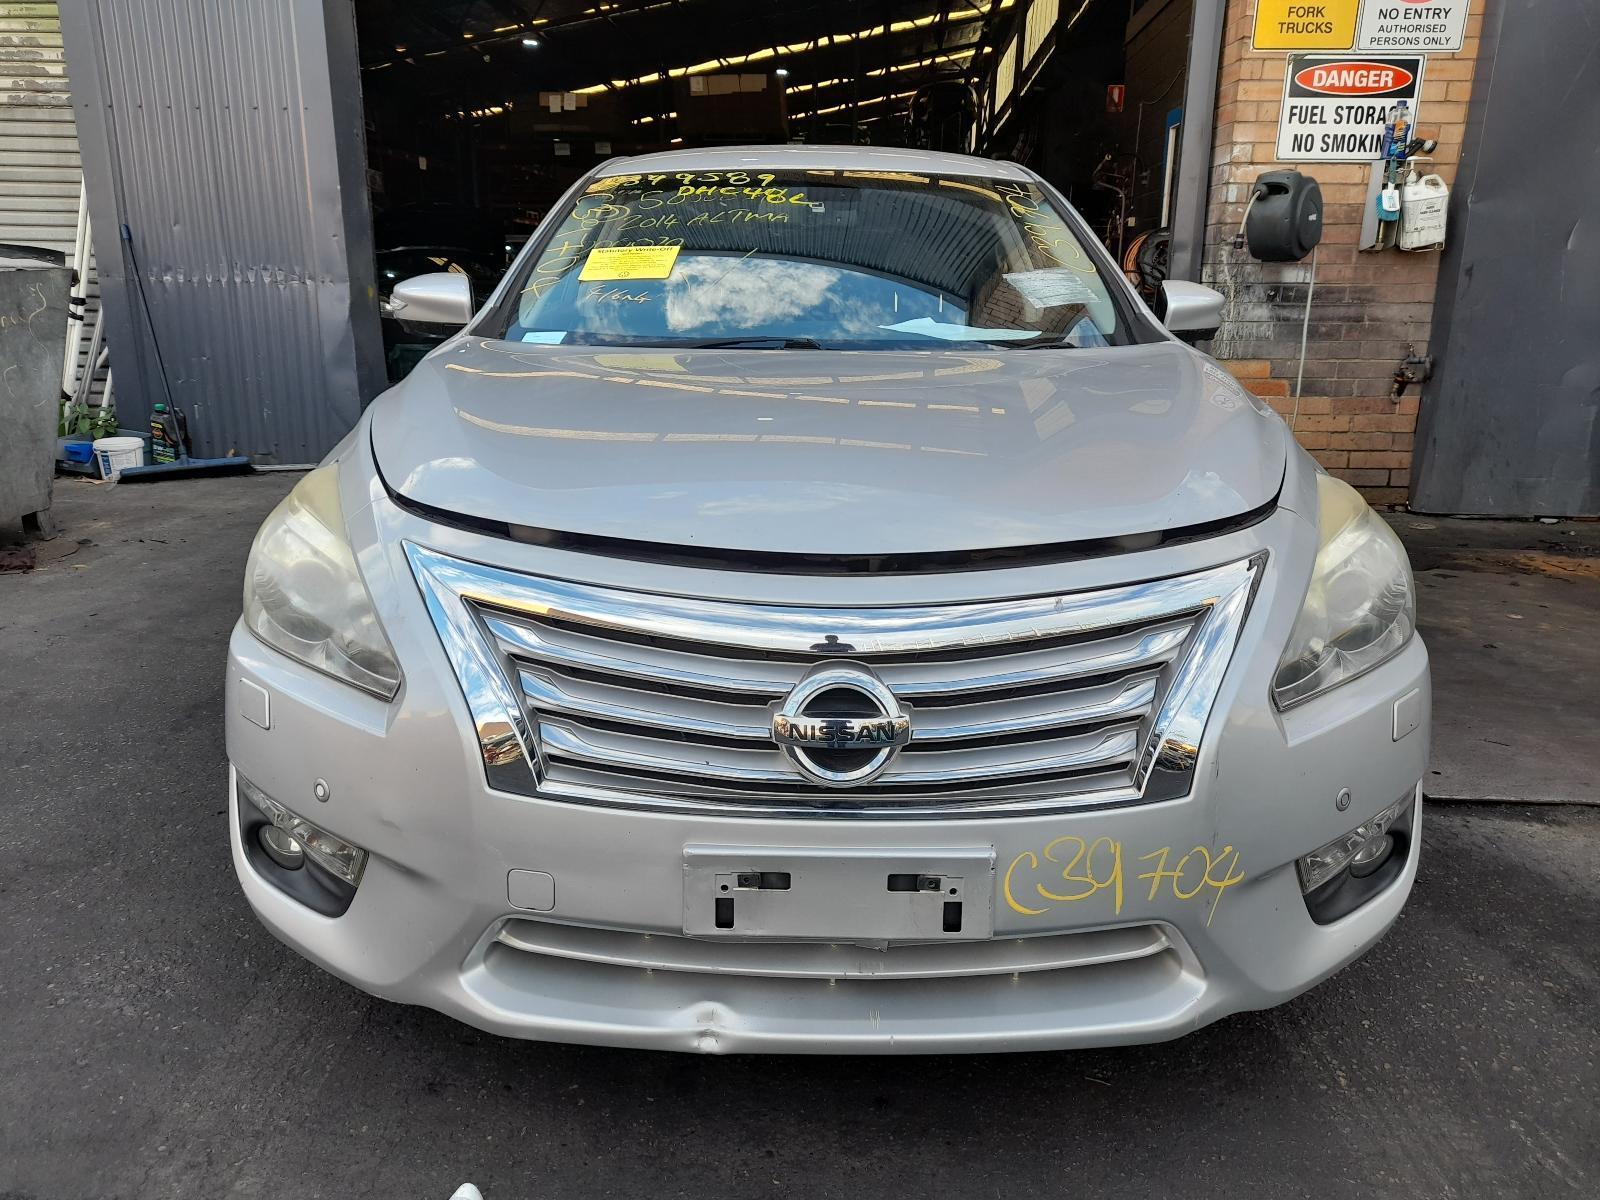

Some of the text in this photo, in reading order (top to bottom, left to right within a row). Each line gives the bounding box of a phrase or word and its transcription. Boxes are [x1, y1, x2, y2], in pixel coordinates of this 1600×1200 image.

[1288, 6, 1325, 18] FORK
[1378, 7, 1452, 20] NO ENTRY
[1278, 22, 1333, 34] TRUCKS
[1378, 24, 1447, 33] AUTHORISED
[1370, 36, 1451, 46] PERSONS ONLY
[1312, 69, 1394, 88] DANGER
[1288, 105, 1400, 125] FUEL STORA
[1292, 133, 1387, 153] NO SMOKIN
[788, 721, 896, 743] NISSAN
